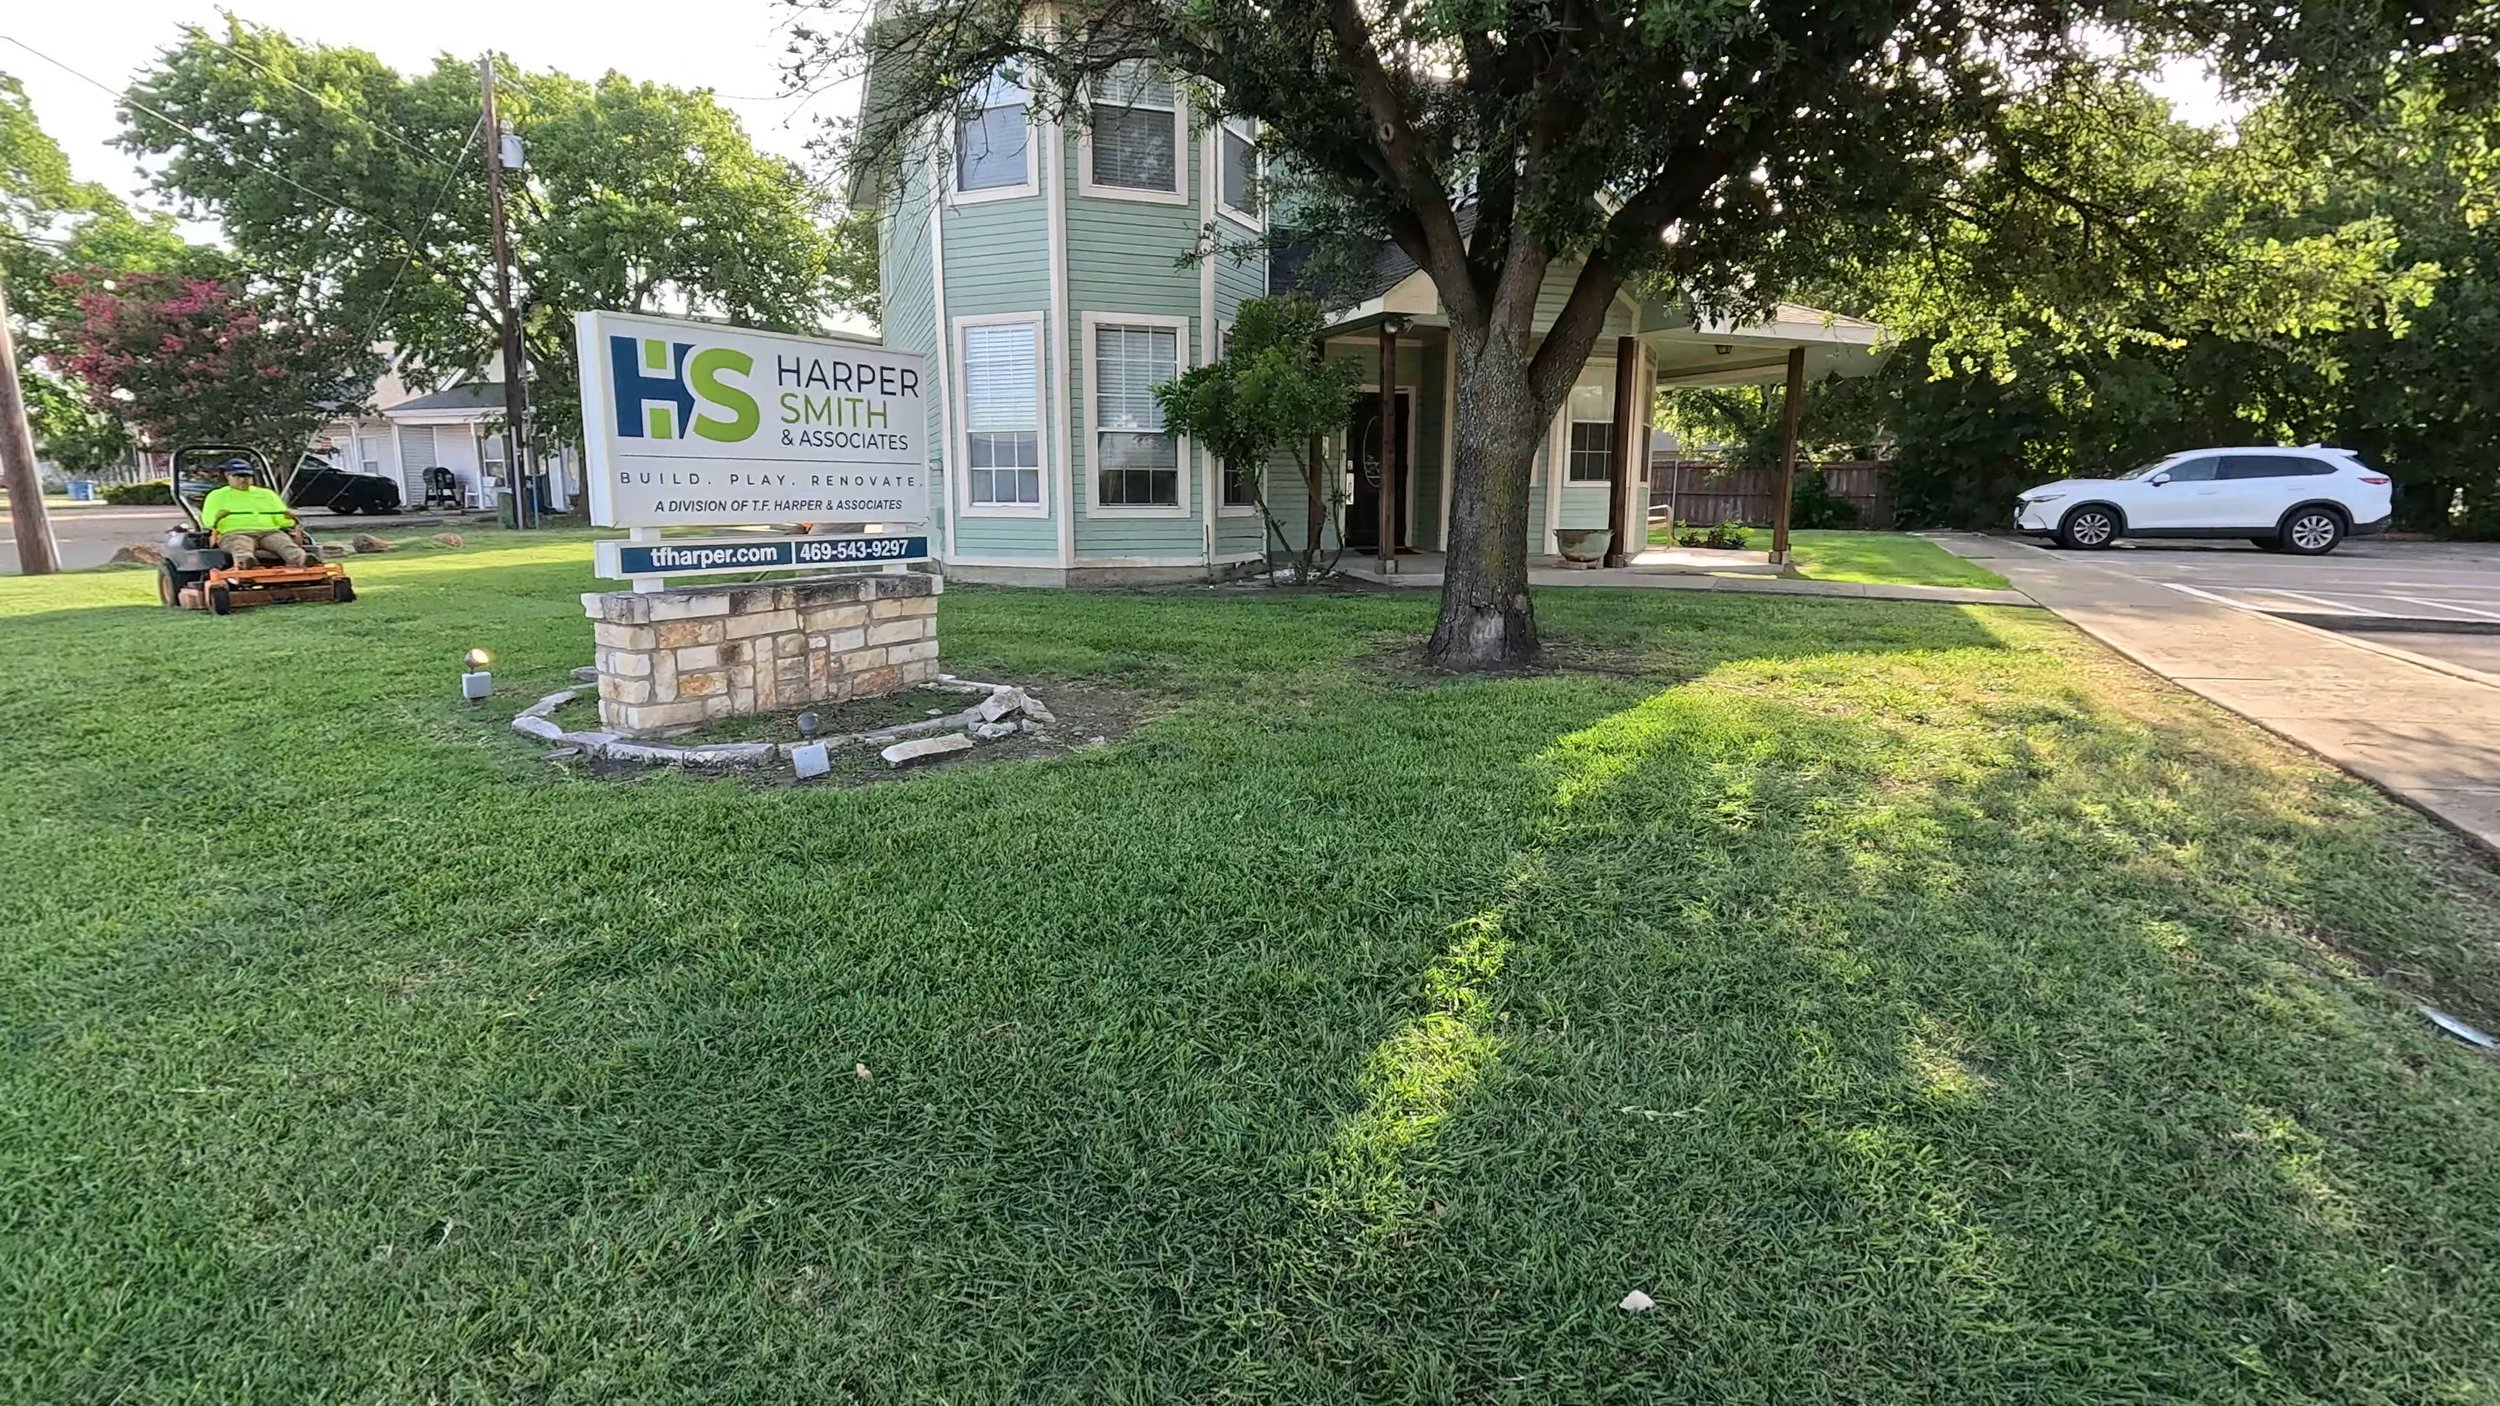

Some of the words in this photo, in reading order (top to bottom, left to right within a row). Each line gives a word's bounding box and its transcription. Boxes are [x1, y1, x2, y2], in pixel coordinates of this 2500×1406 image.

[777, 354, 919, 398] HARPER
[610, 335, 760, 443] HS
[780, 392, 888, 429] SMITH
[781, 429, 794, 447] &
[799, 430, 908, 450] ASSOCIATES
[620, 471, 712, 485] BUILD.
[730, 473, 796, 486] PLAY.
[811, 475, 923, 487] RENOVATE.
[654, 500, 665, 513] A
[668, 500, 727, 512] DIVISION
[731, 500, 748, 512] OF
[752, 500, 770, 512] T.F.
[774, 500, 822, 511] HARPER
[826, 499, 833, 511] &
[836, 499, 902, 511] ASSOCIATES
[650, 546, 778, 569] tfharper.com
[800, 539, 909, 562] 469-543-9297
